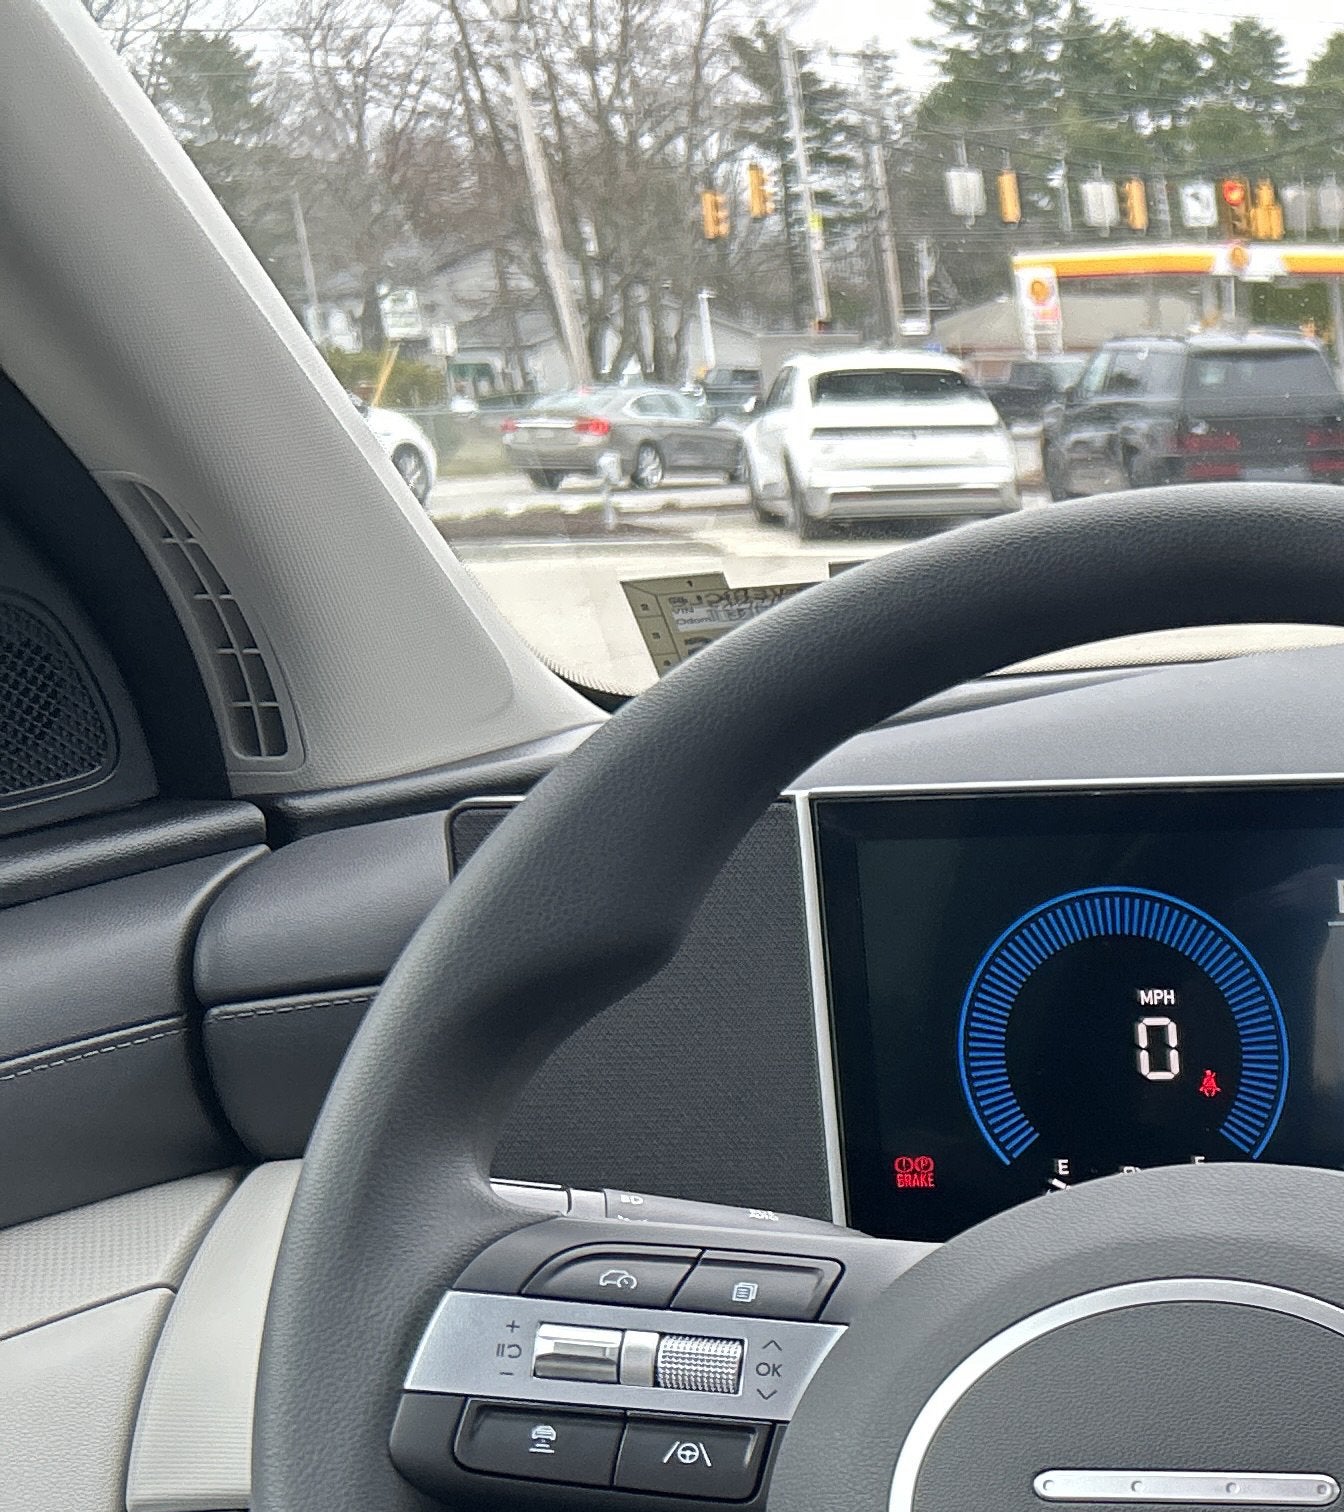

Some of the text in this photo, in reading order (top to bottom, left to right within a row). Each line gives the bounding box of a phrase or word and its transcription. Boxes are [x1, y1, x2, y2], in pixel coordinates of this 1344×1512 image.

[1140, 990, 1174, 1005] MPH
[1058, 1159, 1069, 1175] E
[896, 1173, 935, 1187] BRAKE
[755, 1362, 783, 1378] OK
